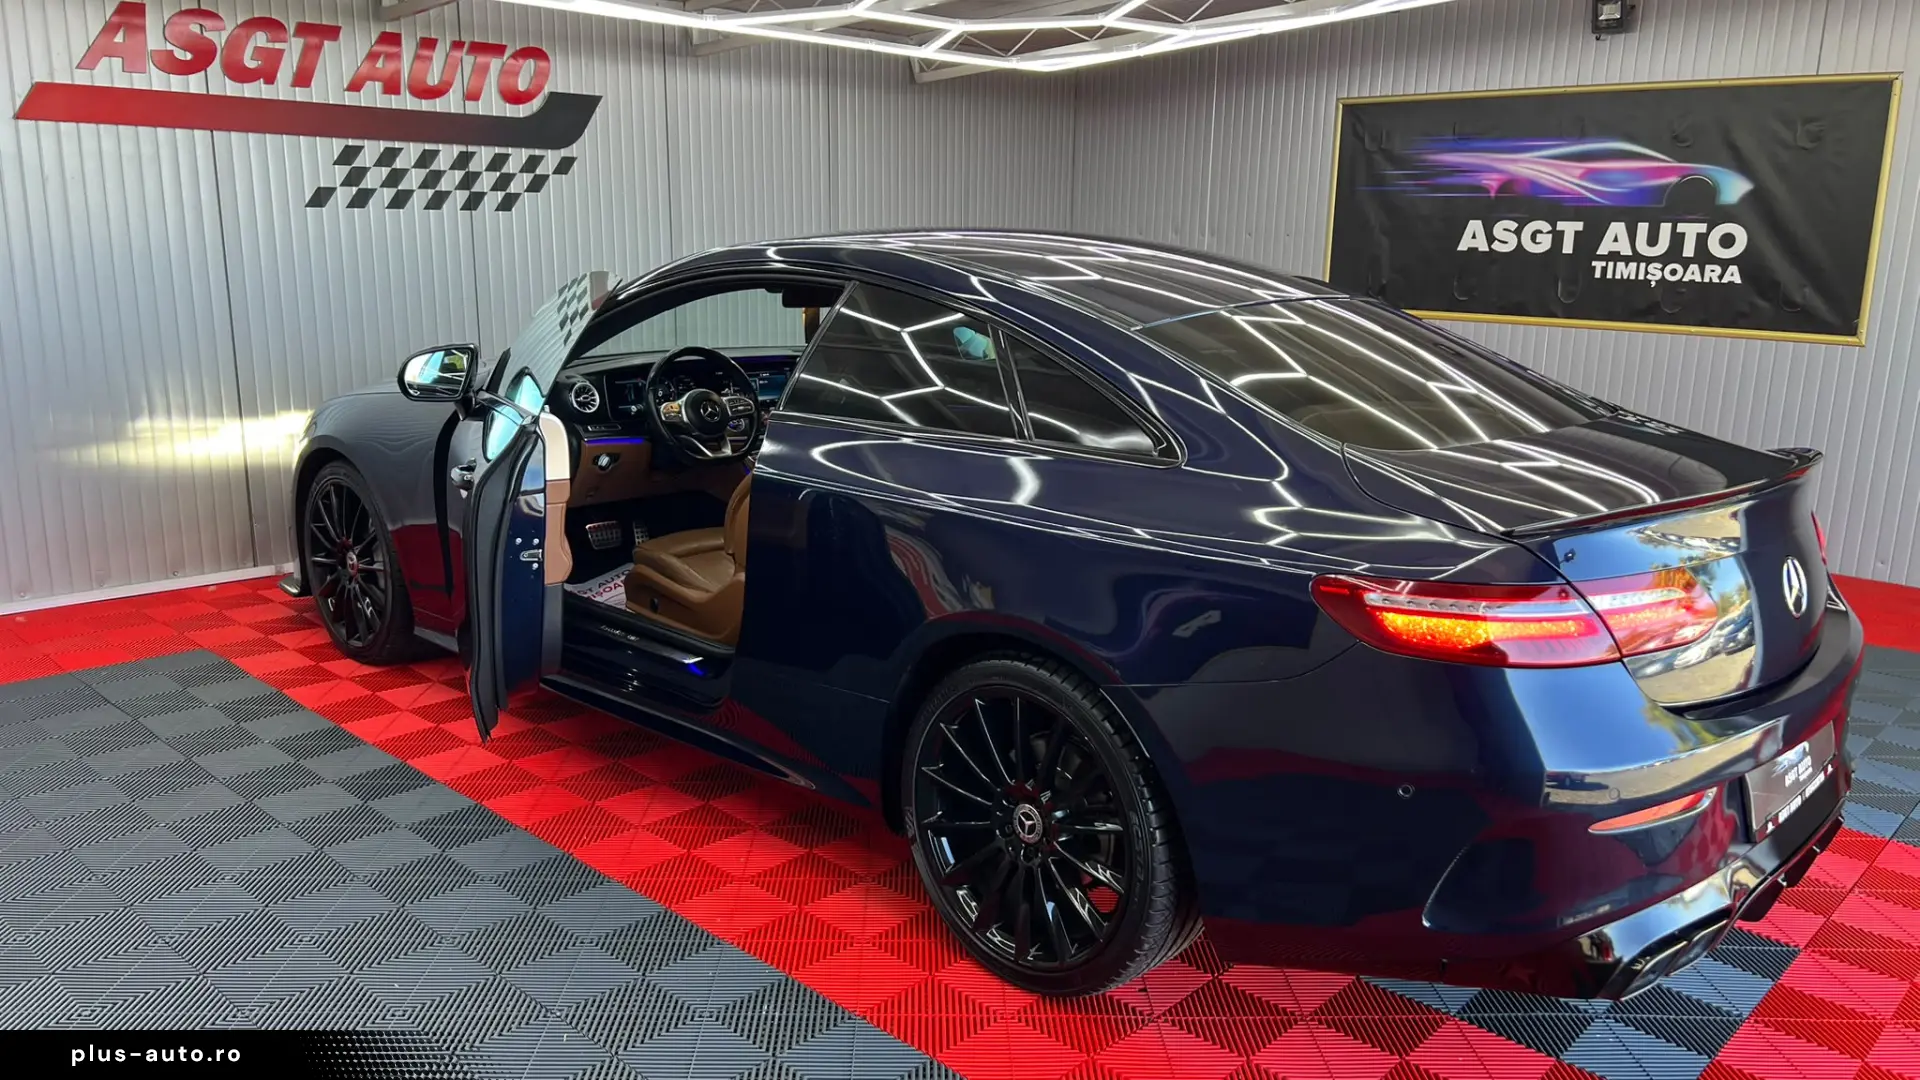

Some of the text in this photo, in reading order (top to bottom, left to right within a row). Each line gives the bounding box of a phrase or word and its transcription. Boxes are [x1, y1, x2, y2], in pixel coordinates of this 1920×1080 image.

[76, 0, 552, 106] ASGT AUTO
[1456, 219, 1748, 259] ASGT AUTO
[1591, 260, 1742, 288] TIMIȘOARA
